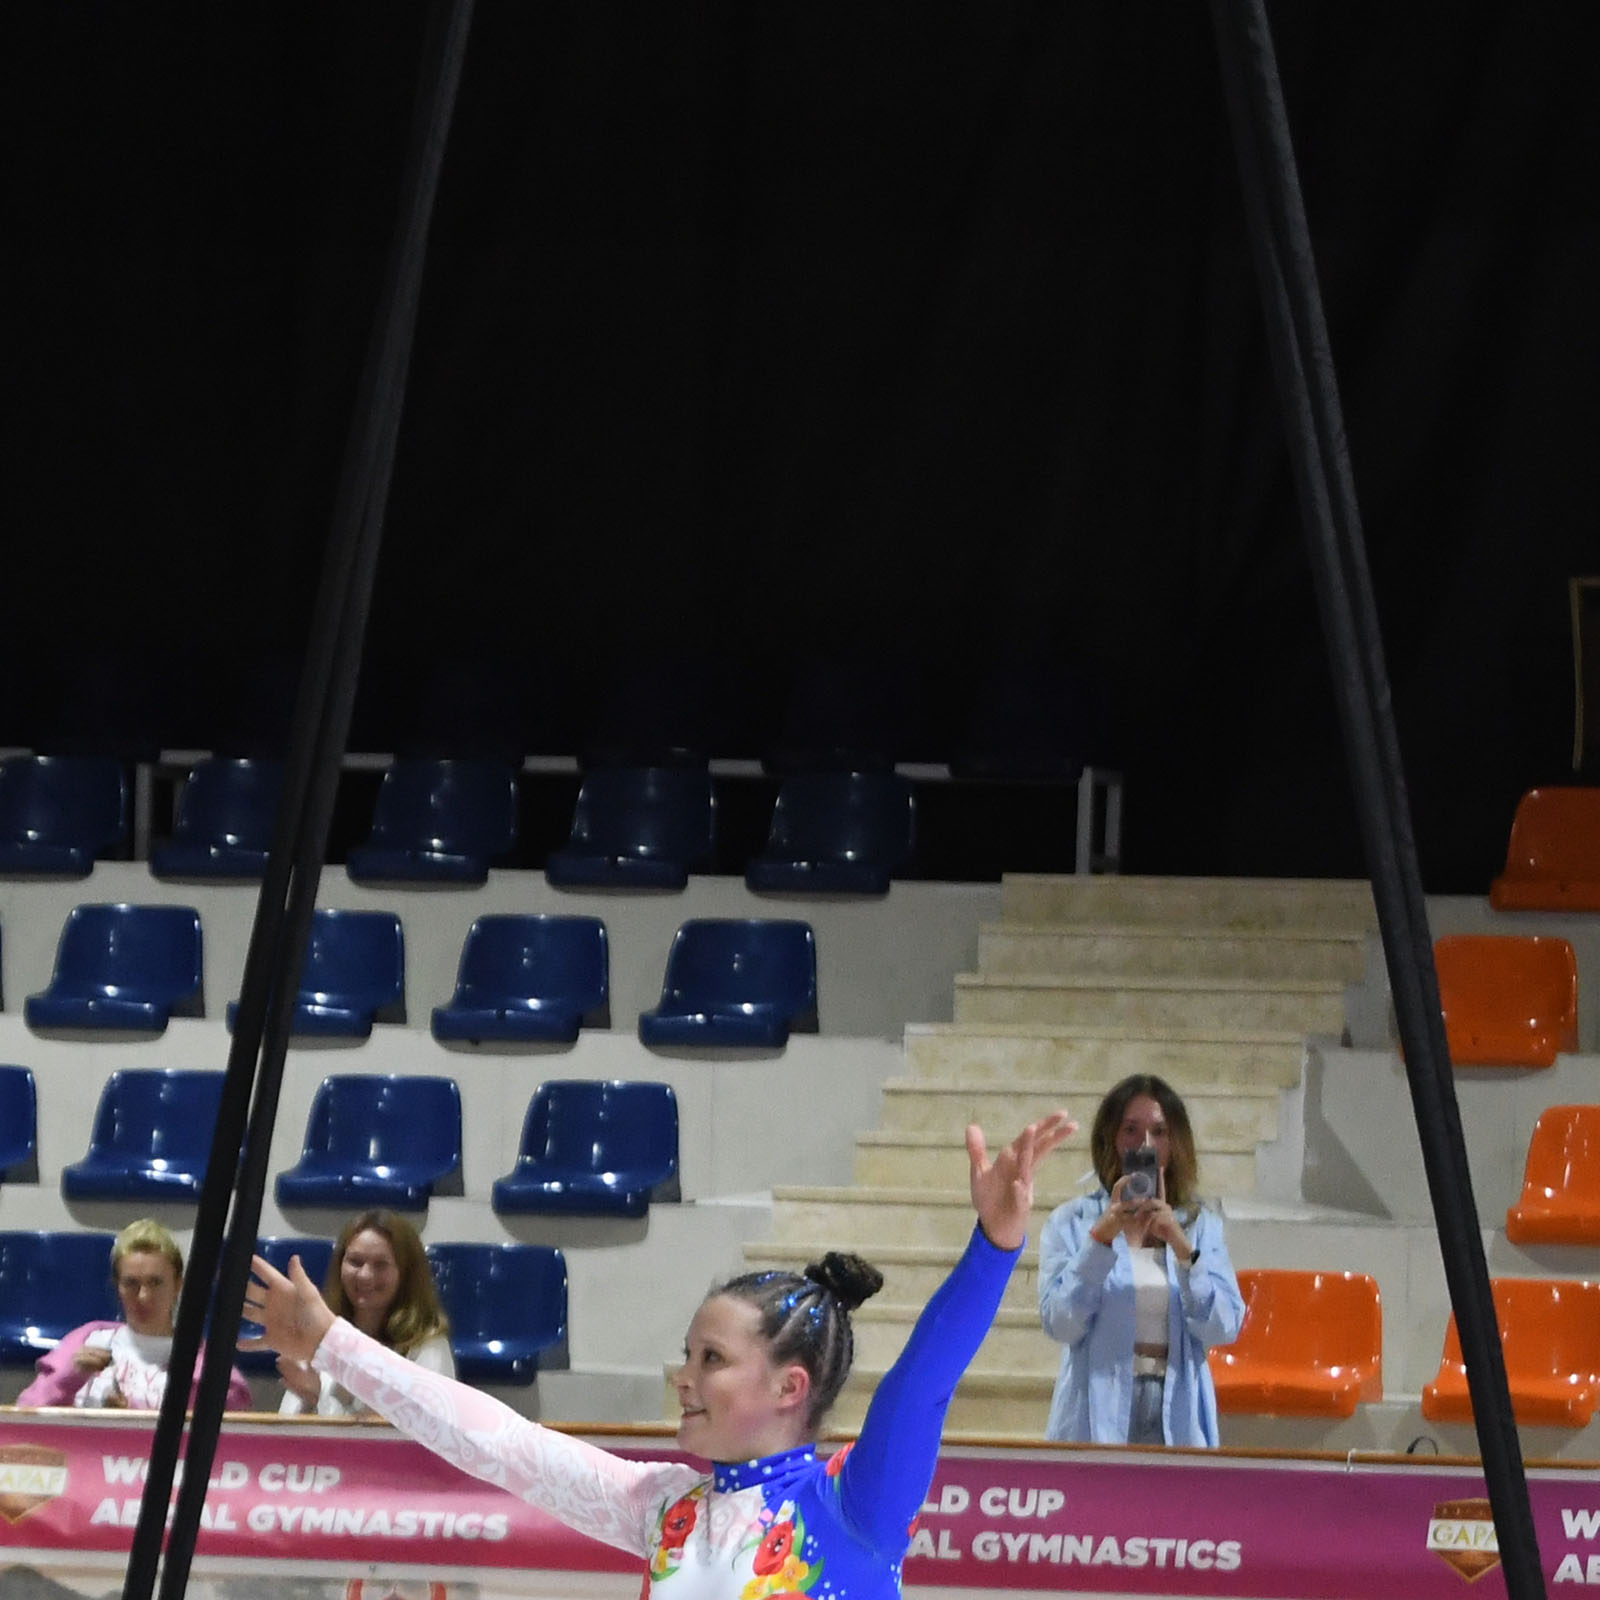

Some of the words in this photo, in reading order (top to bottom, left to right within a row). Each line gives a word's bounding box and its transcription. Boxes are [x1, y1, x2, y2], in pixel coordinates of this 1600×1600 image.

[258, 1463, 341, 1493] CUP
[979, 1486, 1066, 1518] CUP
[247, 1504, 509, 1541] GYMNASTICS
[1432, 1523, 1499, 1547] GAPA
[971, 1530, 1243, 1571] GYMNASTICS
